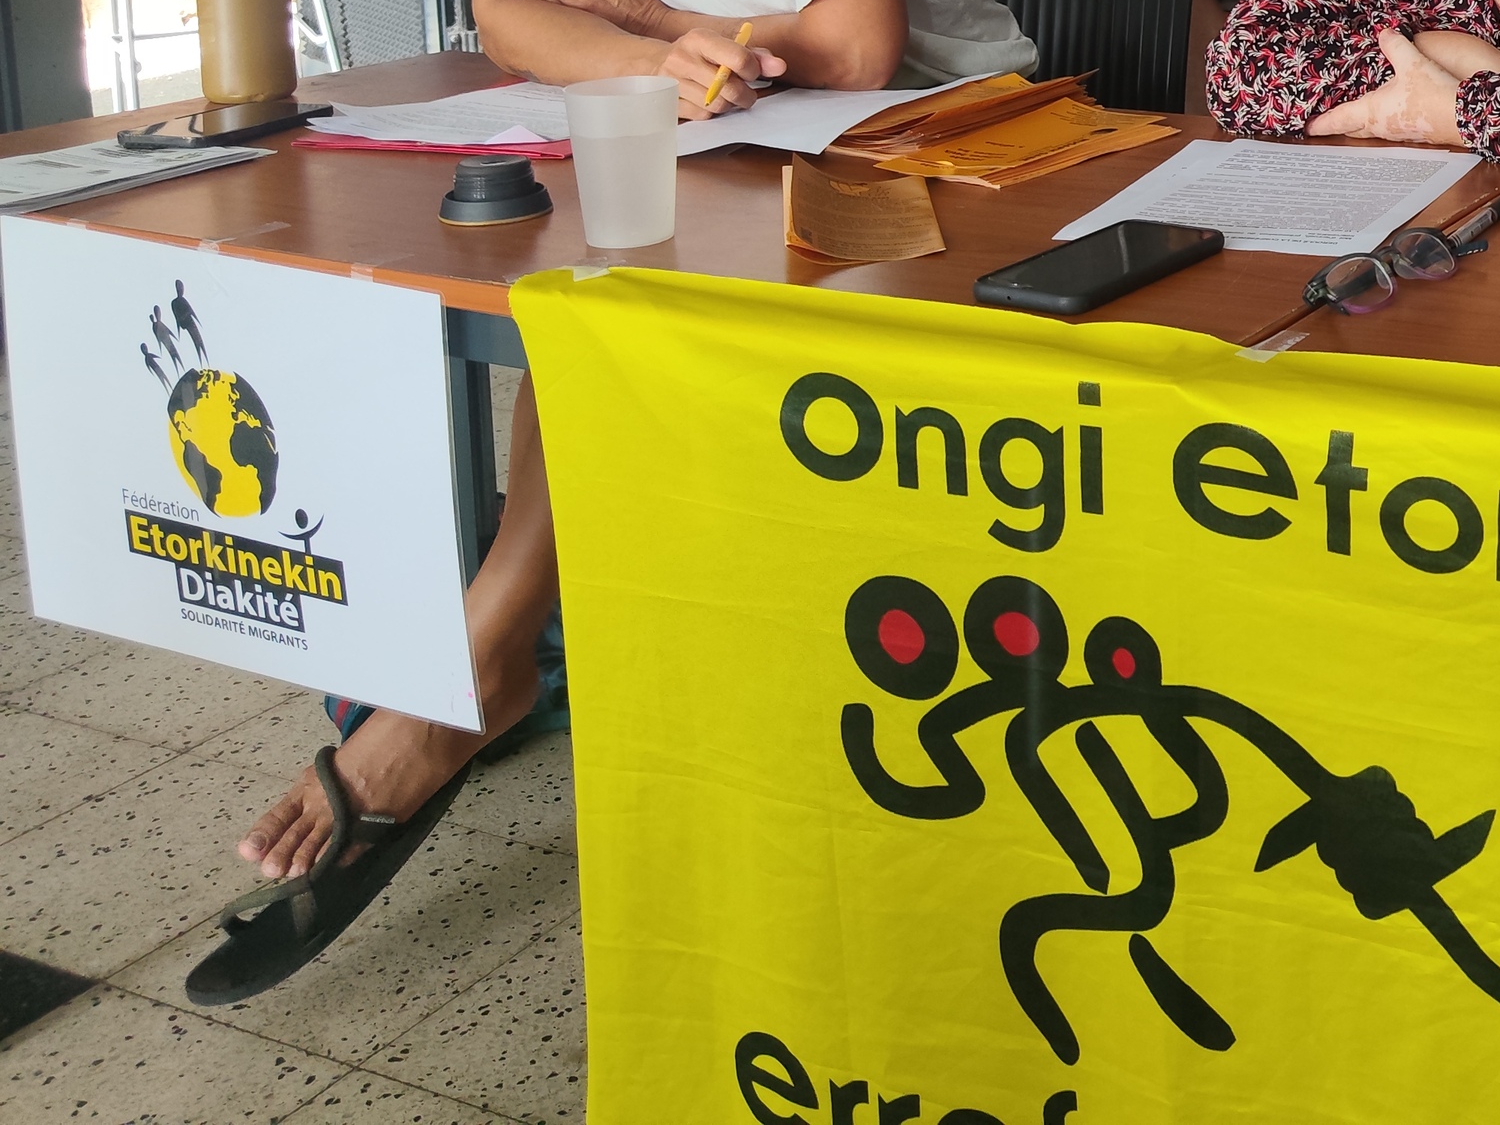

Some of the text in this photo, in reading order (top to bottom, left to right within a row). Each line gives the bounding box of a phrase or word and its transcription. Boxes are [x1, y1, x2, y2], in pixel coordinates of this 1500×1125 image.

[122, 488, 200, 522] Fédération
[130, 515, 342, 600] Etorkinekin
[180, 567, 300, 626] Diakité
[181, 608, 308, 650] SOLIDARITÉ MIGRANTS
